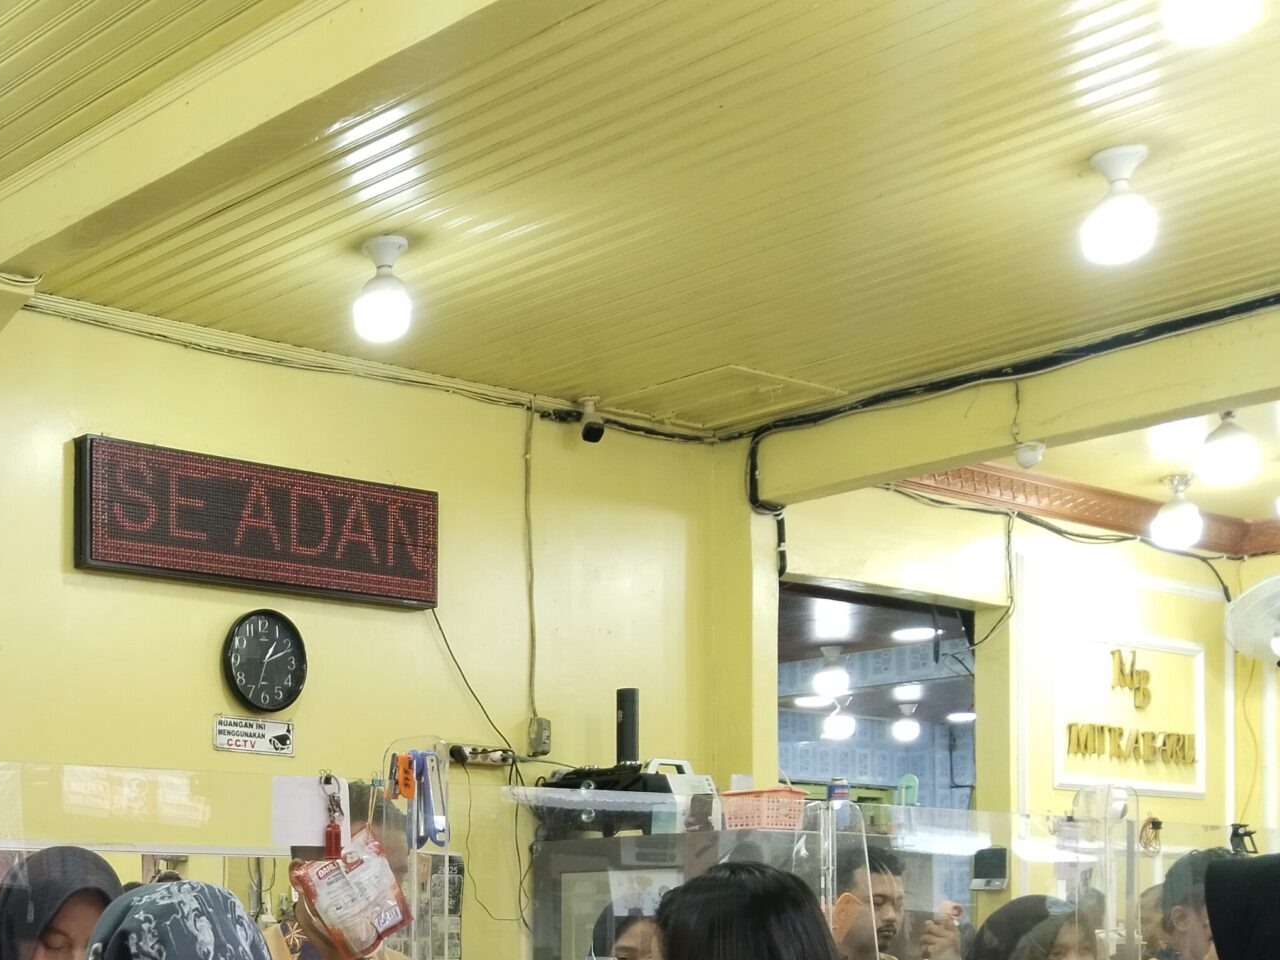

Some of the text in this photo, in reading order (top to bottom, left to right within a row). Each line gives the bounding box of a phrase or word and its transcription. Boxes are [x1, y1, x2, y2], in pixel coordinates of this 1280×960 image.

[258, 619, 269, 633] 12
[218, 719, 266, 730] RUANGAN INI
[218, 728, 266, 739] MENGGUNAKAN
[226, 738, 257, 749] CCTV
